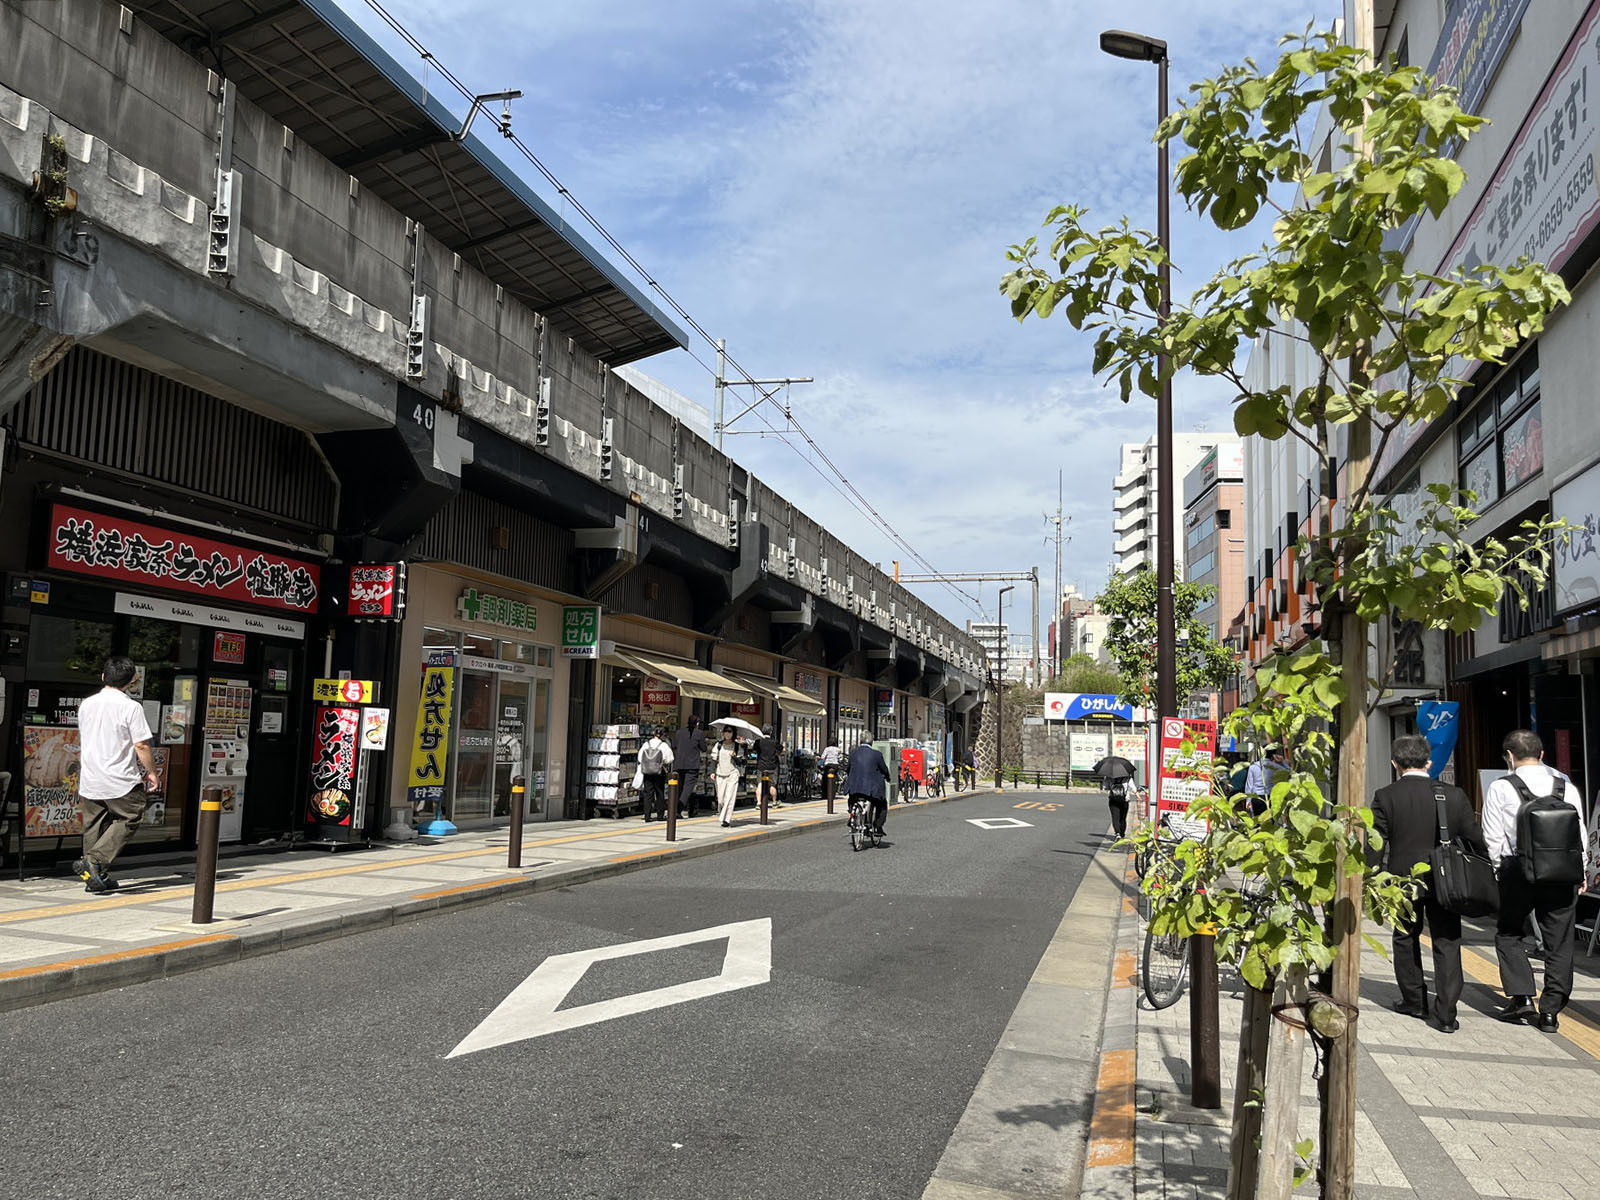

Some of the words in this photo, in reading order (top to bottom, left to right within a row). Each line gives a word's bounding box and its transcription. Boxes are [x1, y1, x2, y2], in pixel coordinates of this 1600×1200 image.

[413, 404, 433, 430] 40
[639, 515, 649, 532] 41
[55, 517, 244, 589] 横浜家系ラーメン
[760, 558, 768, 572] 42
[350, 583, 393, 602] ラーメン
[482, 594, 537, 631] 調剤薬局
[565, 611, 594, 627] 処方
[565, 628, 593, 643] せん
[648, 693, 672, 702] 免税店
[1081, 698, 1126, 711] ひがしん
[311, 710, 341, 790] ラーメン
